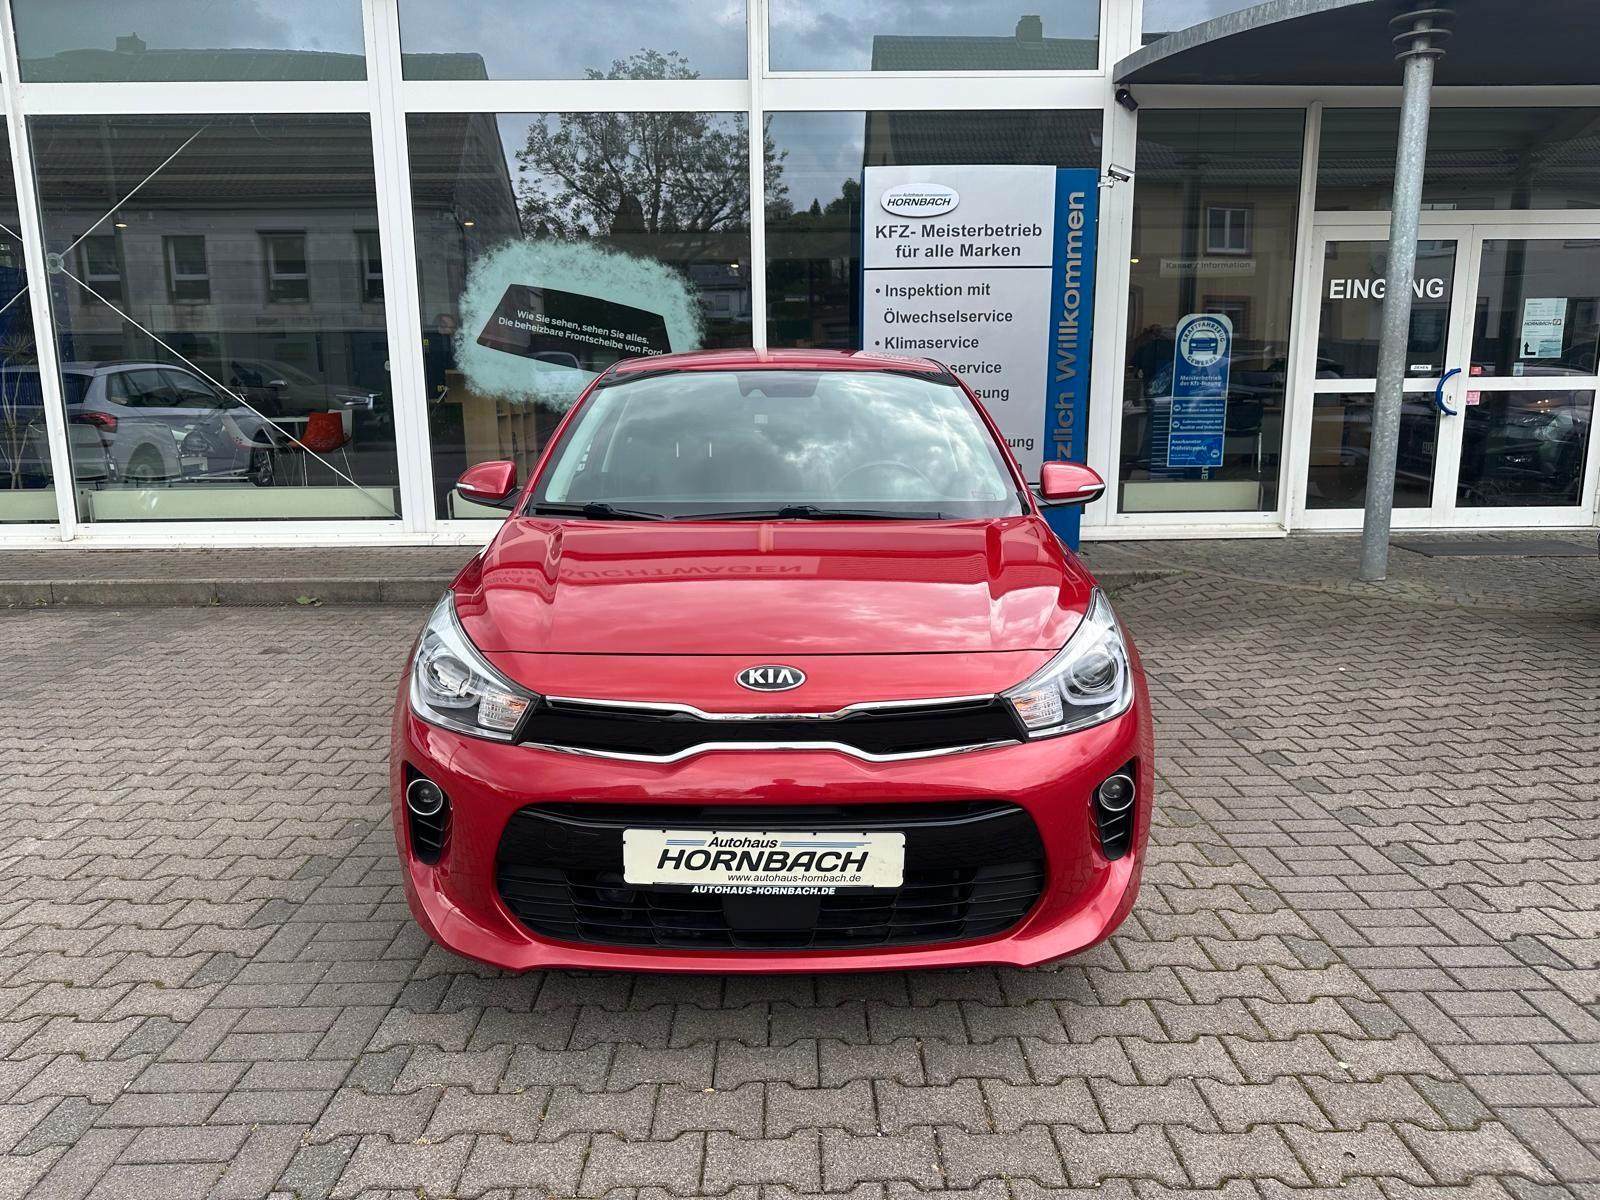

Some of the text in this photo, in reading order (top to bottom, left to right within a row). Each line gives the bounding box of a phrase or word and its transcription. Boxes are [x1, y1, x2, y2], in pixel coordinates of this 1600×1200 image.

[887, 197, 952, 207] HORNBACH
[875, 223, 1043, 239] KFZ- Meisterbetrieb
[895, 244, 1021, 258] für alle Marken
[885, 283, 991, 300] Inspektion mit
[1055, 191, 1086, 383] Willkommen
[1329, 278, 1444, 299] EINGNG
[883, 307, 1013, 324] Ölwechselservice
[498, 316, 513, 328] Die
[514, 320, 564, 338] beheizbare
[565, 330, 624, 350] Frontscheibe
[624, 343, 641, 354] von
[517, 309, 650, 345] Wie Sie sehen, sehen Sie alles.
[884, 336, 980, 349] Klimaservice
[748, 669, 794, 684] KIA
[708, 836, 779, 849] Autohaus
[656, 848, 869, 873] HORNBACH
[727, 872, 862, 884] www.autohaus-hornbach.de
[691, 885, 836, 896] AUTOHAUS-HORNBACH.DE
